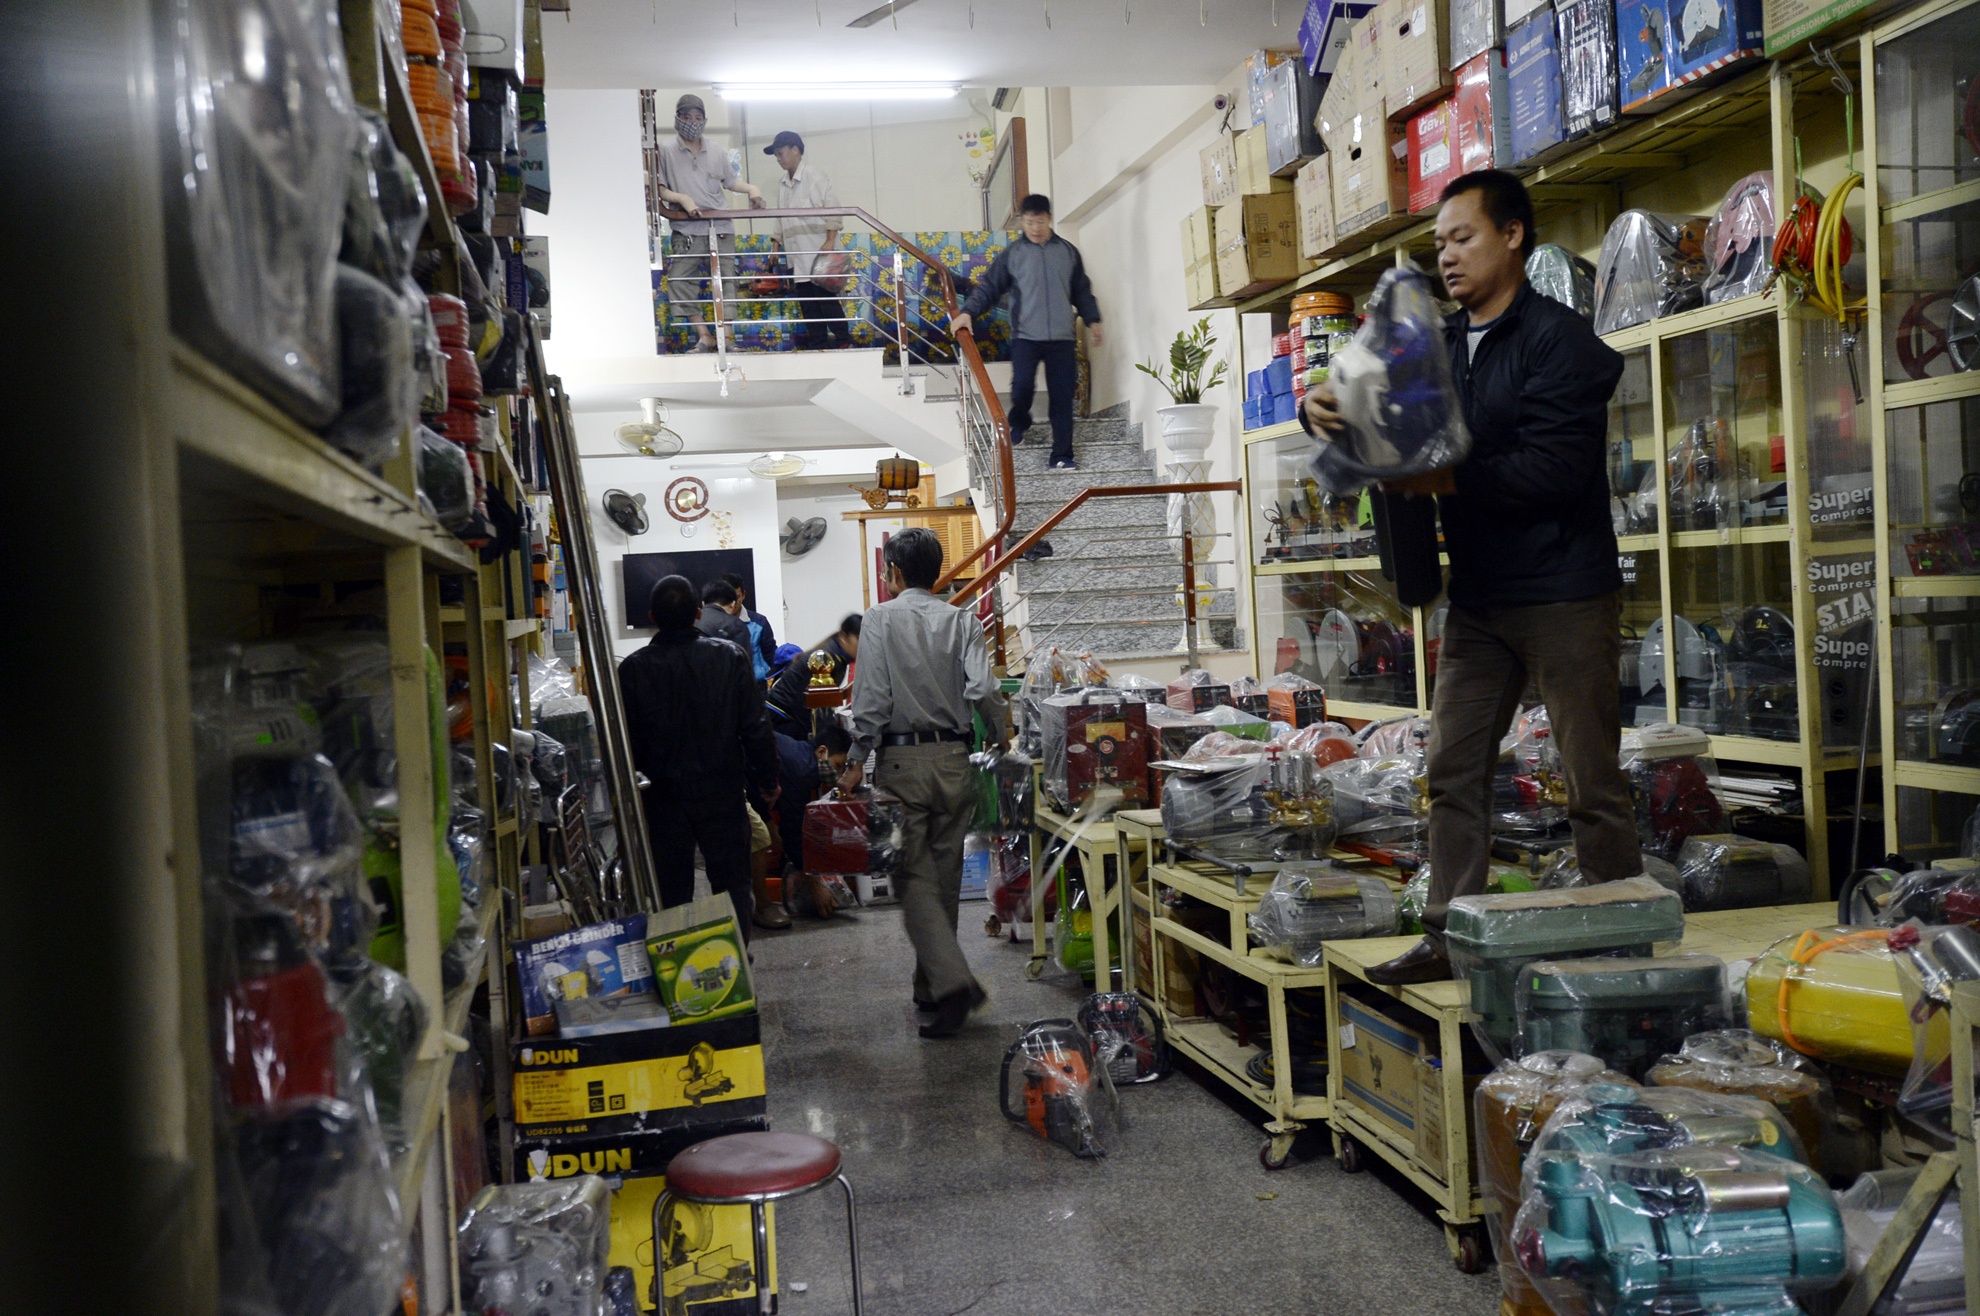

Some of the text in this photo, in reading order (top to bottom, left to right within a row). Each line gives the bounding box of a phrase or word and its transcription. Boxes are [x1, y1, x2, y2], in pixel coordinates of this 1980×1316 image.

[1771, 13, 1831, 49] PROFESSIONAL
[1808, 486, 1873, 510] Super
[1810, 505, 1874, 524] Compres
[1807, 560, 1873, 581] Super
[1822, 622, 1839, 633] AIR
[1813, 635, 1870, 659] Supe
[1812, 656, 1868, 669] Compre
[531, 923, 625, 954] BENCH GRINDER
